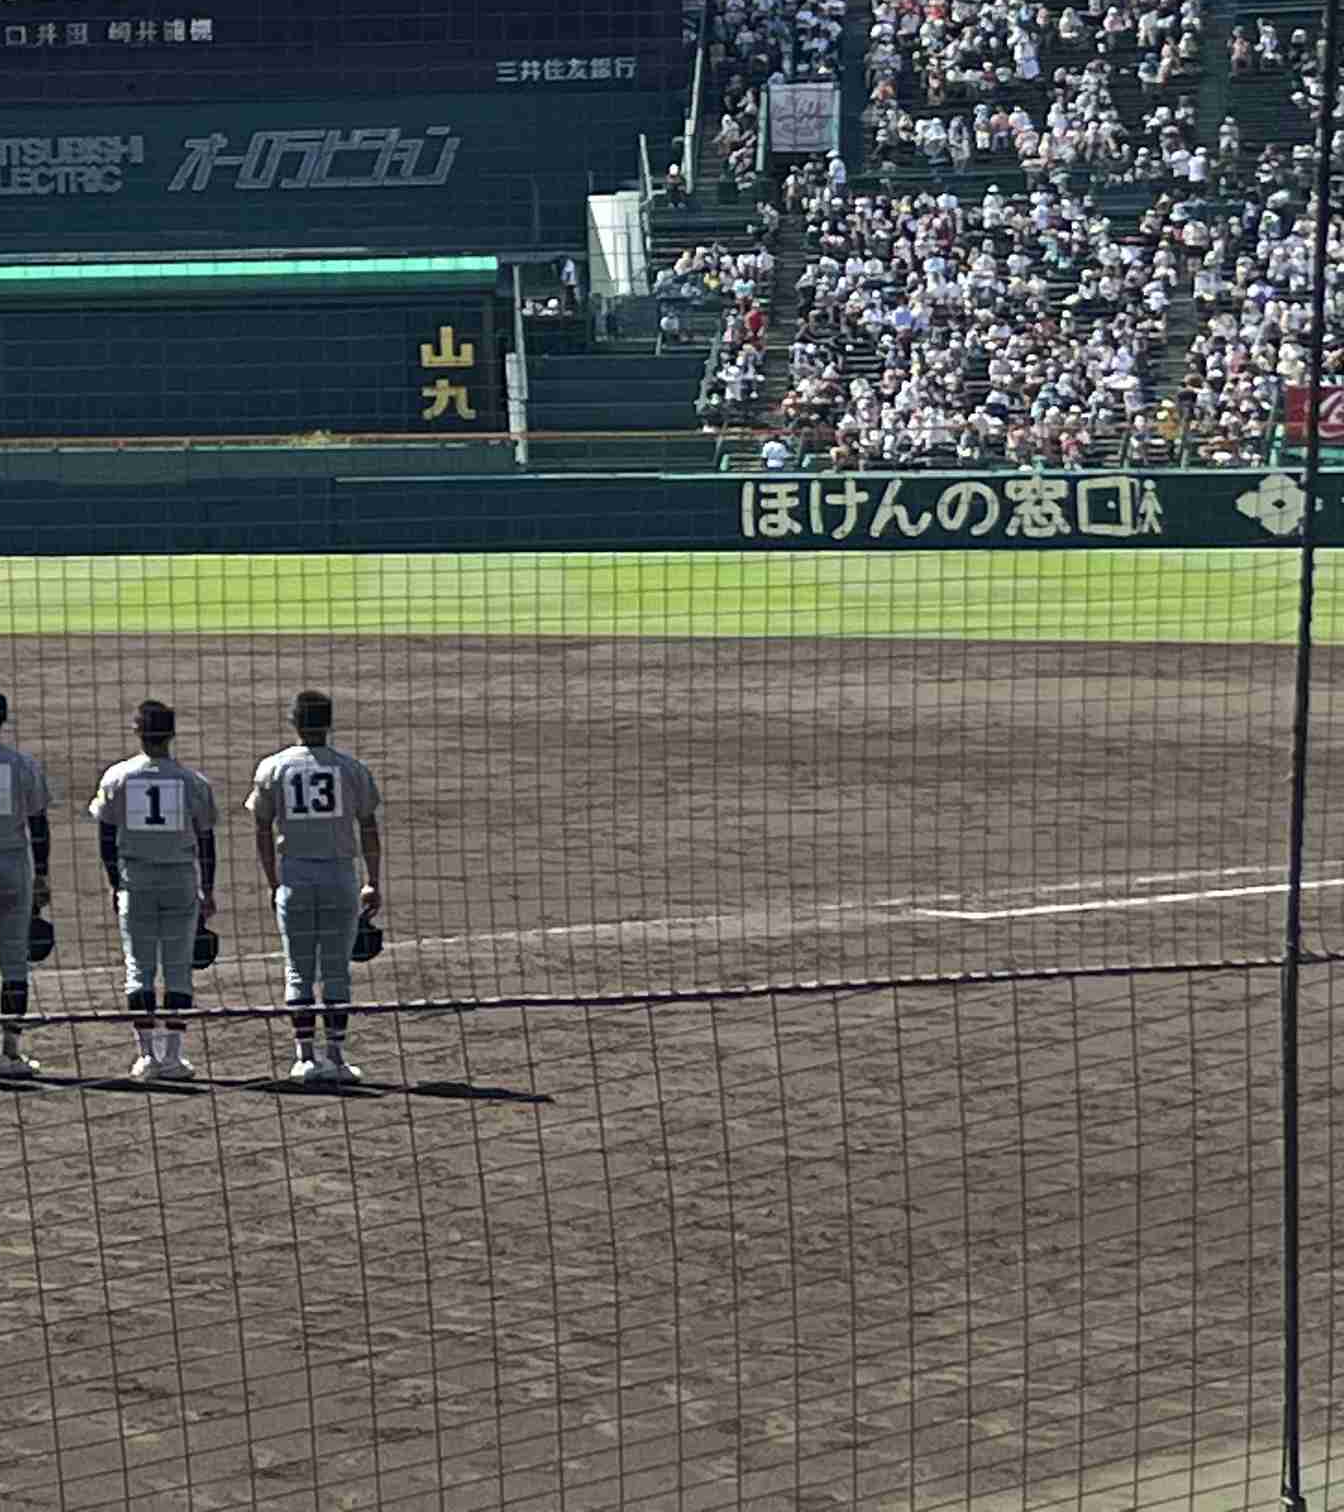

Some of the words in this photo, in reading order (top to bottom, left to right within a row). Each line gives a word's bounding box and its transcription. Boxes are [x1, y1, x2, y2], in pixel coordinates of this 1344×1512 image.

[496, 57, 638, 83] 三井住友銀行
[741, 476, 1138, 540] ほけんの窓口
[145, 786, 165, 824] 1
[290, 772, 335, 813] 13
